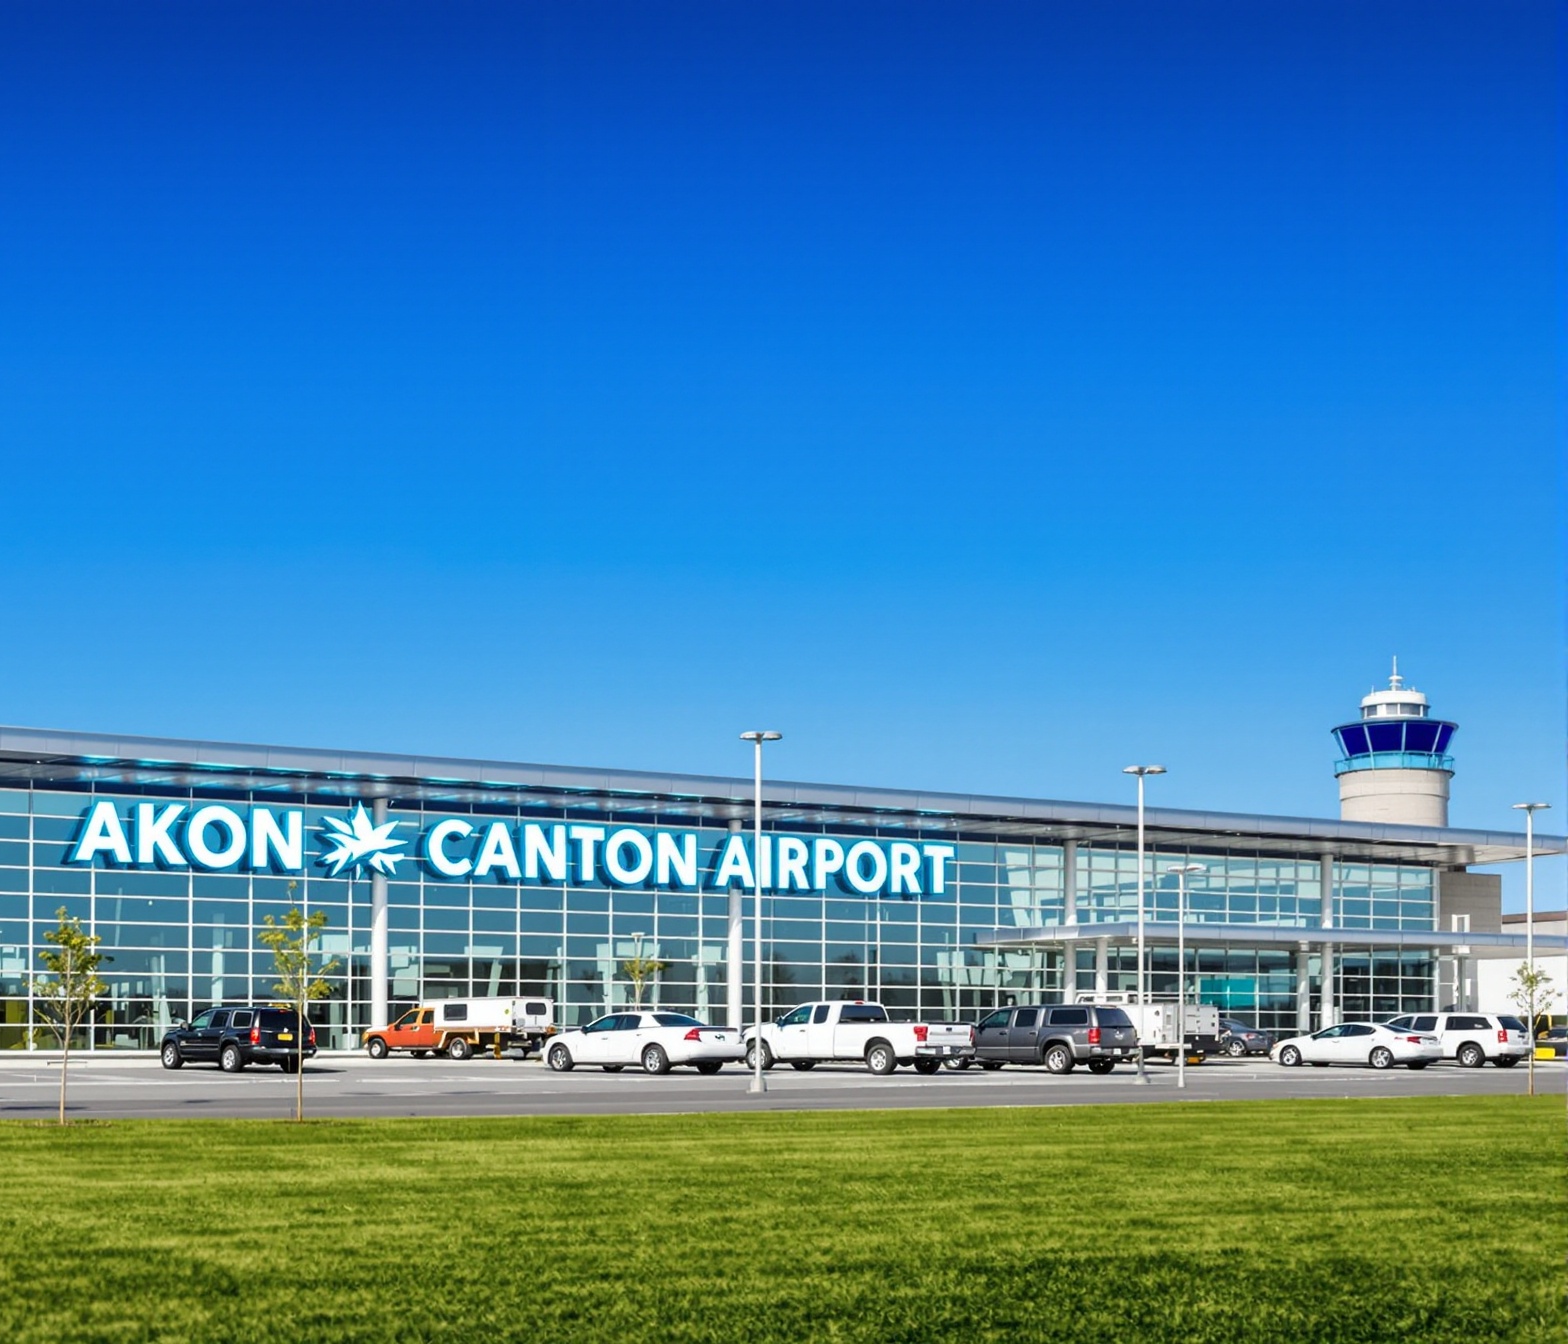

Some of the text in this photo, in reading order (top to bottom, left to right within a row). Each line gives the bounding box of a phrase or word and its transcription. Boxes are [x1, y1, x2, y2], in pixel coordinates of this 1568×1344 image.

[73, 800, 955, 894] AKON CANTON AIRPORT
